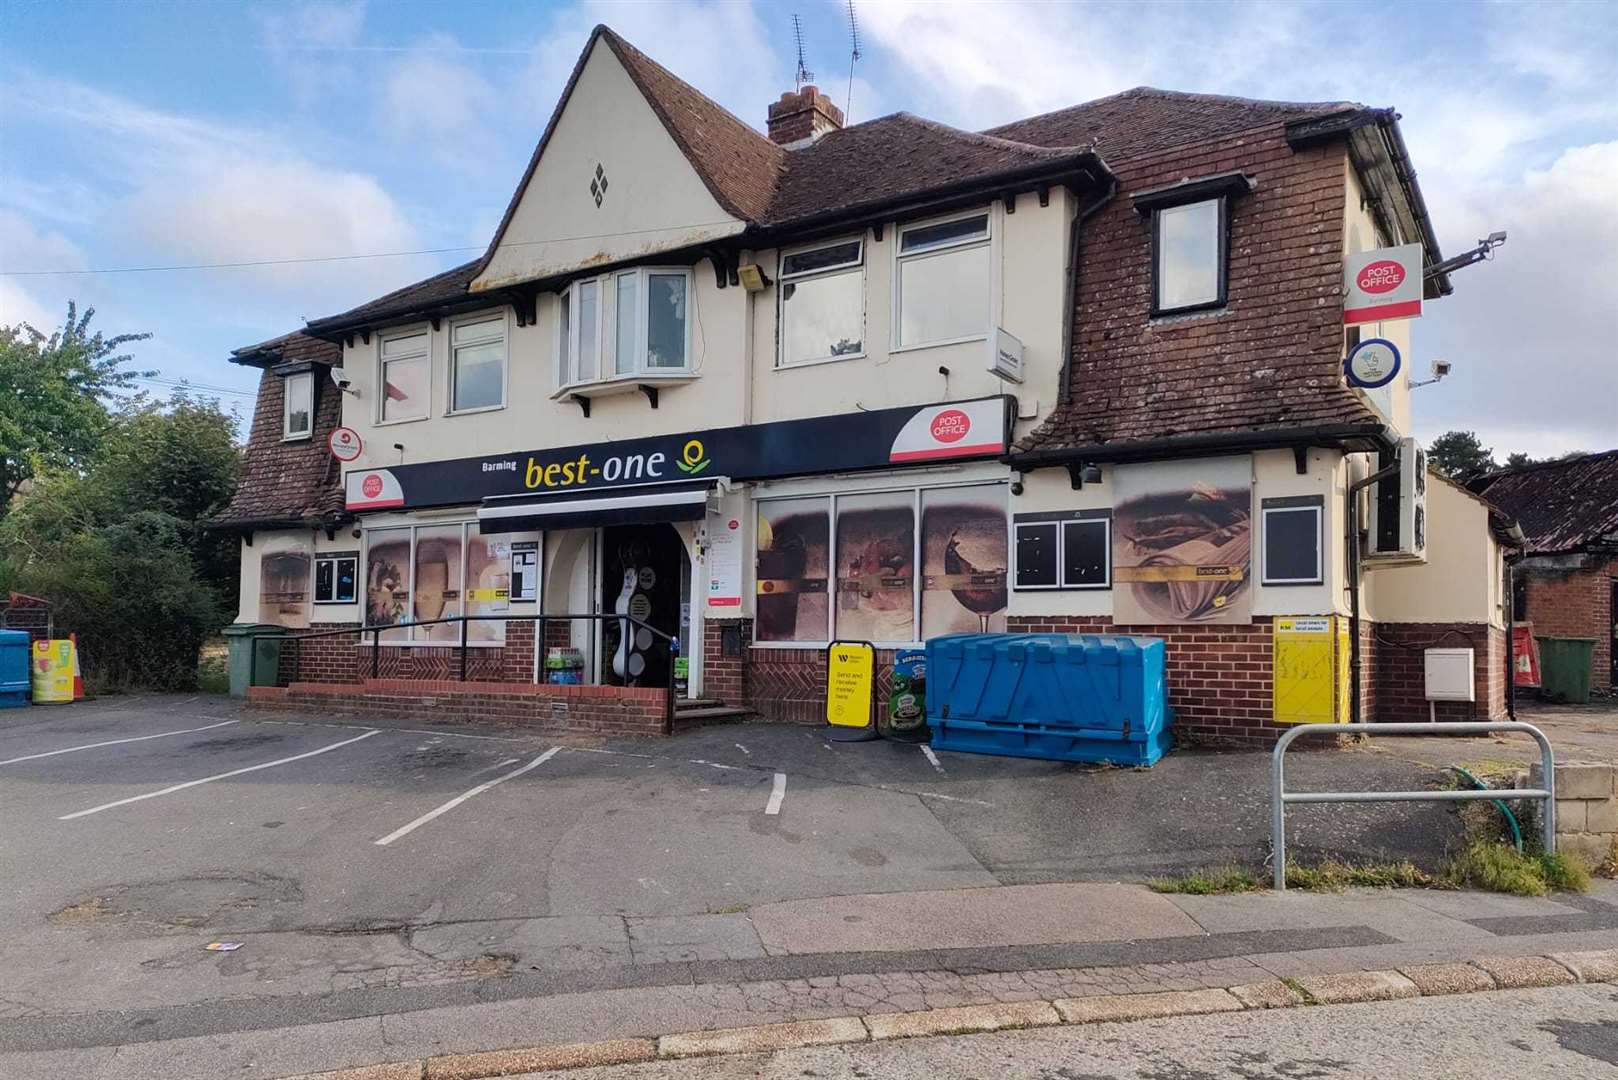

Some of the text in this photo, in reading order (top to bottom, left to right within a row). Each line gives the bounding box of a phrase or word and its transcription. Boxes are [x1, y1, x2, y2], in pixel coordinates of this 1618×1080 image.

[1367, 265, 1395, 278] POST
[1361, 274, 1400, 289] OFFICE
[939, 415, 962, 426] POST
[934, 424, 965, 436] OFFICE
[482, 452, 665, 489] Barming best-one
[364, 485, 380, 493] OFFICE
